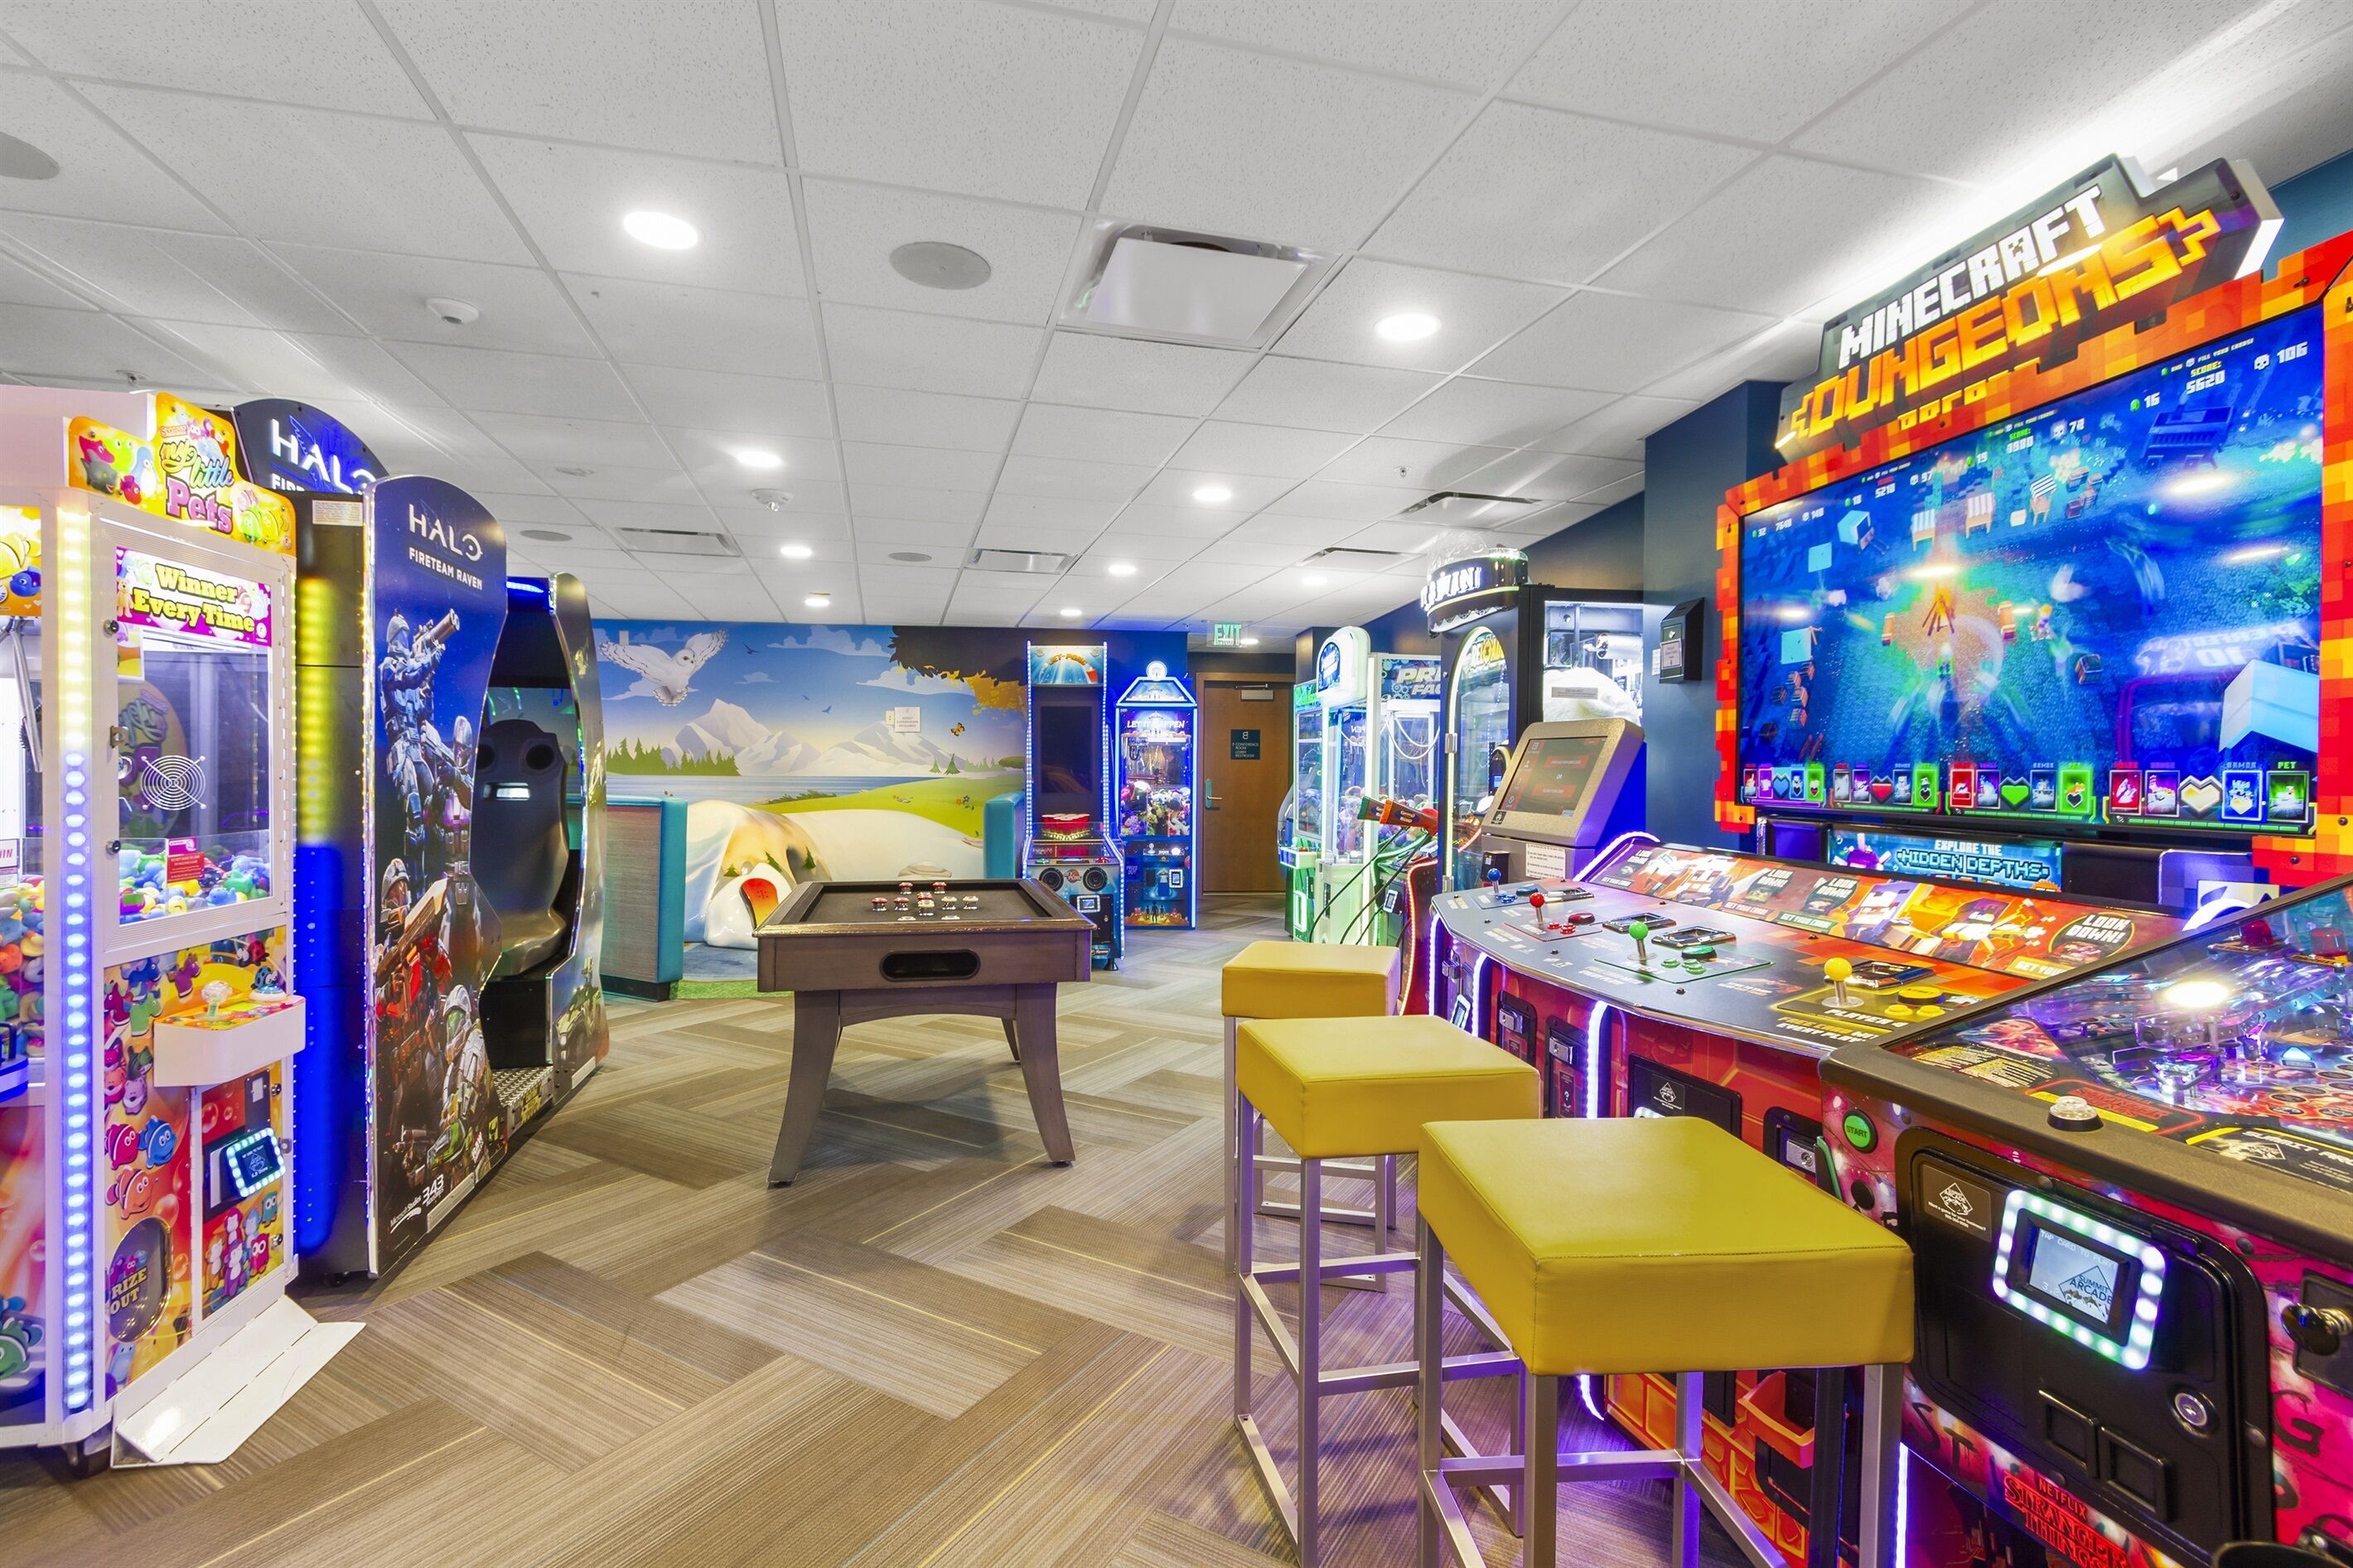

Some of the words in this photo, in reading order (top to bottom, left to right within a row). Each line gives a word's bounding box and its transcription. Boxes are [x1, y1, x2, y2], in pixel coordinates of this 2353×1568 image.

[1838, 184, 2106, 369] MINECRAFT
[2277, 341, 2308, 364] 106
[2190, 359, 2222, 378] SCORE:
[2186, 369, 2225, 395] 5620
[2143, 392, 2161, 408] 16
[271, 417, 376, 495] HALO
[189, 456, 235, 489] little
[166, 474, 234, 535] Pets
[408, 504, 483, 562] HALO
[408, 547, 455, 579] FIRETEAM
[456, 569, 483, 590] RAVEN
[154, 562, 239, 604] Winner
[132, 586, 201, 629] Every
[201, 601, 255, 633] Time
[1214, 624, 1242, 646] EXIT
[1395, 666, 1441, 684] PRI
[2278, 761, 2297, 770] PET
[1935, 840, 1979, 854] EXPLORE
[1981, 843, 2003, 856] THE
[1897, 848, 1964, 871] HIDDEN
[1964, 854, 2051, 880] DEPTHS
[2081, 914, 2132, 931] LOOK
[2066, 924, 2127, 944] DOWN!
[2014, 961, 2041, 972] GET
[1776, 1016, 1817, 1027] FREE
[1814, 1022, 1854, 1035] CARD
[1823, 1008, 1894, 1025] PLAYER
[1776, 1022, 1824, 1037] EVERY
[1846, 1125, 1868, 1138] START
[2241, 1130, 2319, 1152] SUMMIT
[422, 1173, 445, 1207] 343
[2041, 1231, 2055, 1241] TAP
[2057, 1239, 2076, 1252] CARD
[112, 1266, 147, 1300] RIZE
[2069, 1278, 2113, 1305] ARCADE
[2079, 1275, 2109, 1294] SUMMIT
[110, 1286, 140, 1315] OUT
[2039, 1479, 2087, 1521] NETFLIX
